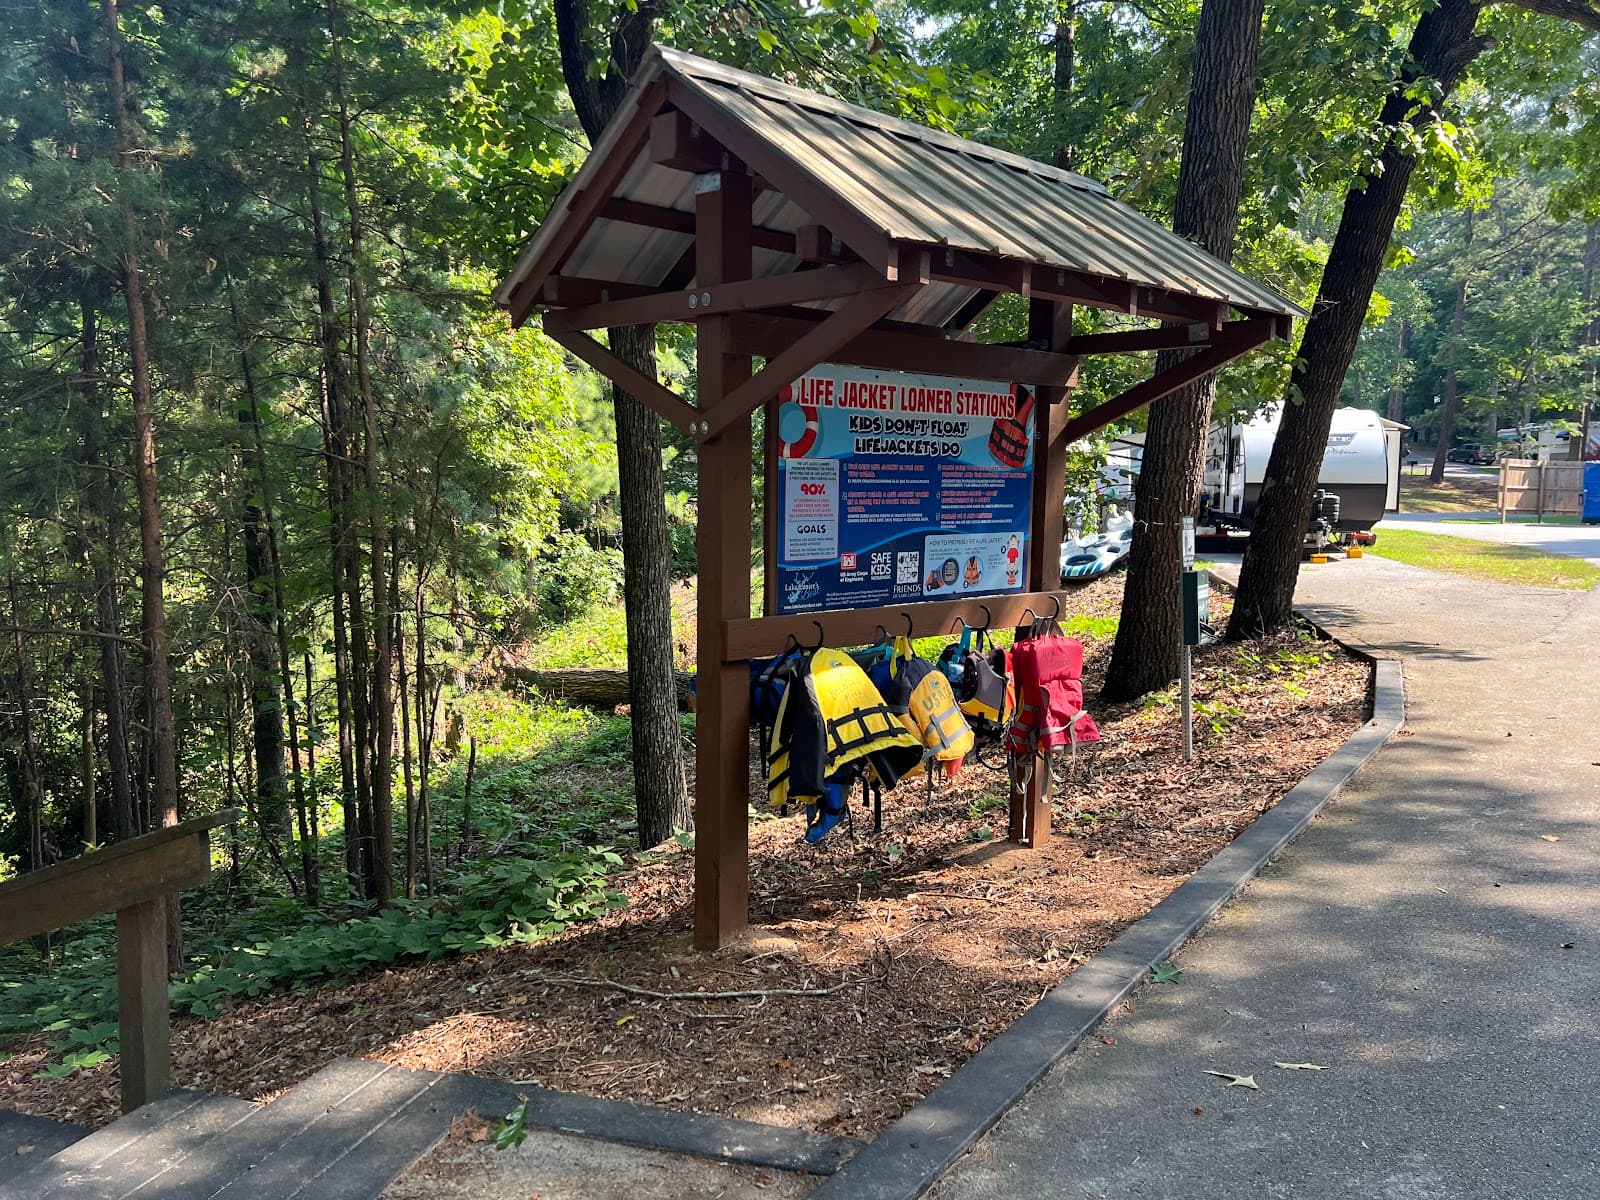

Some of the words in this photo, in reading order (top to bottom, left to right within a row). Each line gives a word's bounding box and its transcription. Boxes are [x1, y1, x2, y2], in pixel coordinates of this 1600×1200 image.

[799, 377, 835, 407] LIFE
[838, 381, 897, 411] JACKET
[900, 385, 953, 415] LOANER
[956, 391, 1016, 419] STATIONS
[849, 415, 883, 434] KIDS
[885, 417, 930, 437] DON'T
[930, 419, 969, 438] FLOAT
[940, 441, 963, 458] DO
[800, 483, 826, 496] 90%
[797, 524, 827, 534] GOALS
[871, 552, 892, 564] SAFE
[870, 563, 892, 575] KIDS
[893, 584, 921, 594] FRIENDS
